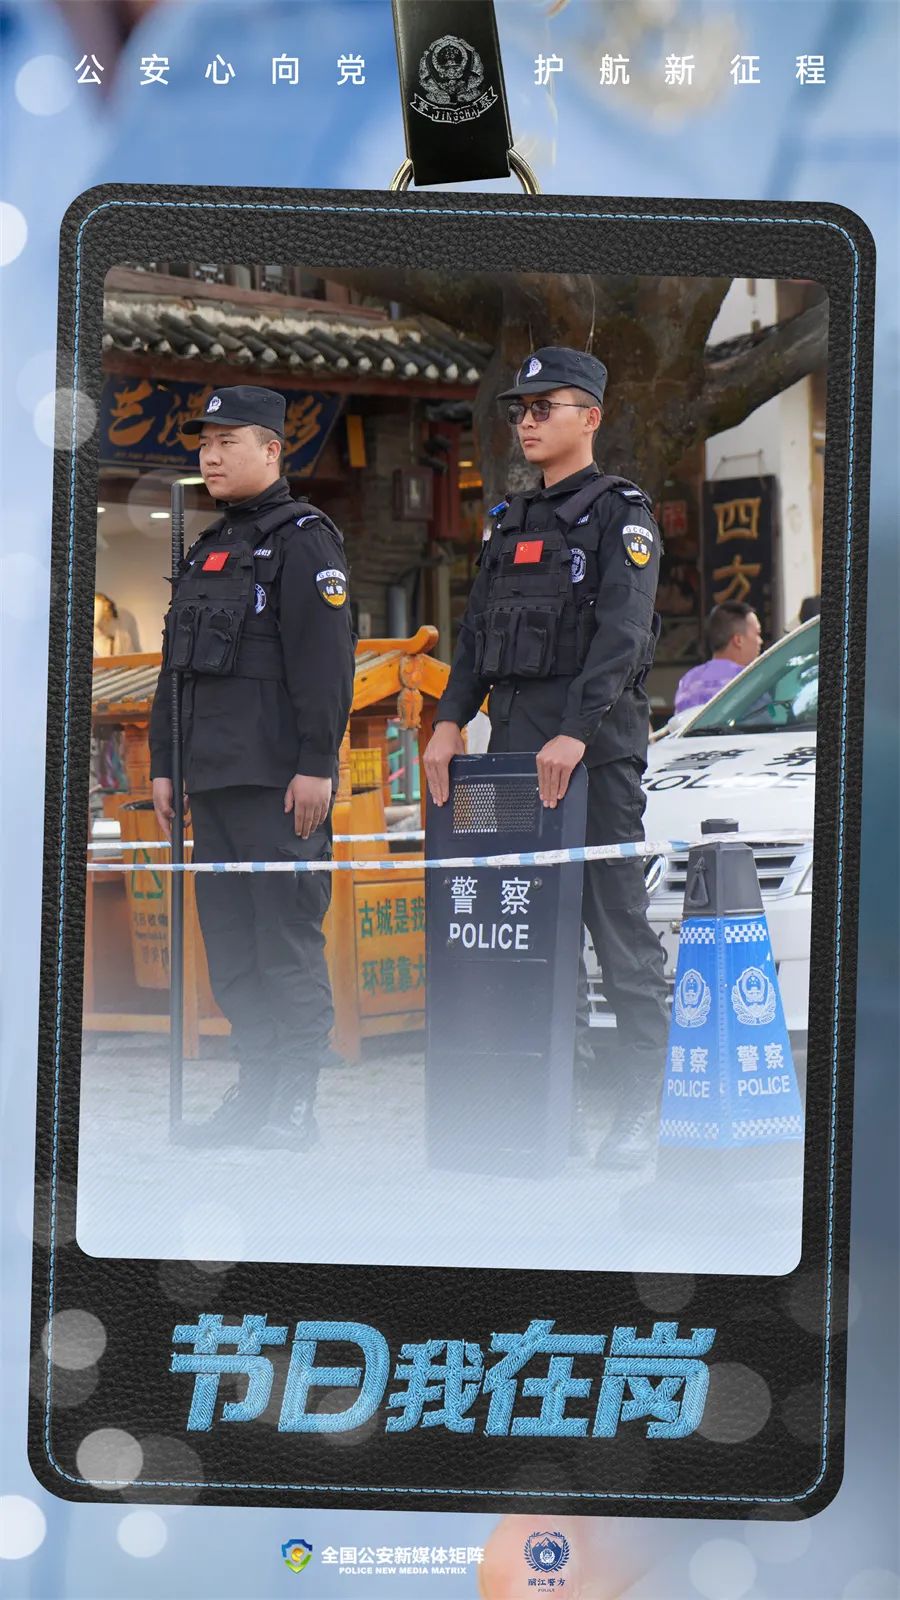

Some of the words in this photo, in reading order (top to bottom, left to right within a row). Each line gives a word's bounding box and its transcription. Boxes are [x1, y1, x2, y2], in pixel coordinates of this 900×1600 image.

[713, 497, 762, 603] 四方
[450, 876, 531, 915] 警察
[449, 923, 529, 950] POLICE
[670, 1045, 708, 1073] 警察
[736, 1042, 784, 1072] 警察
[667, 1079, 710, 1098] POLICE
[737, 1075, 791, 1096] POLICE
